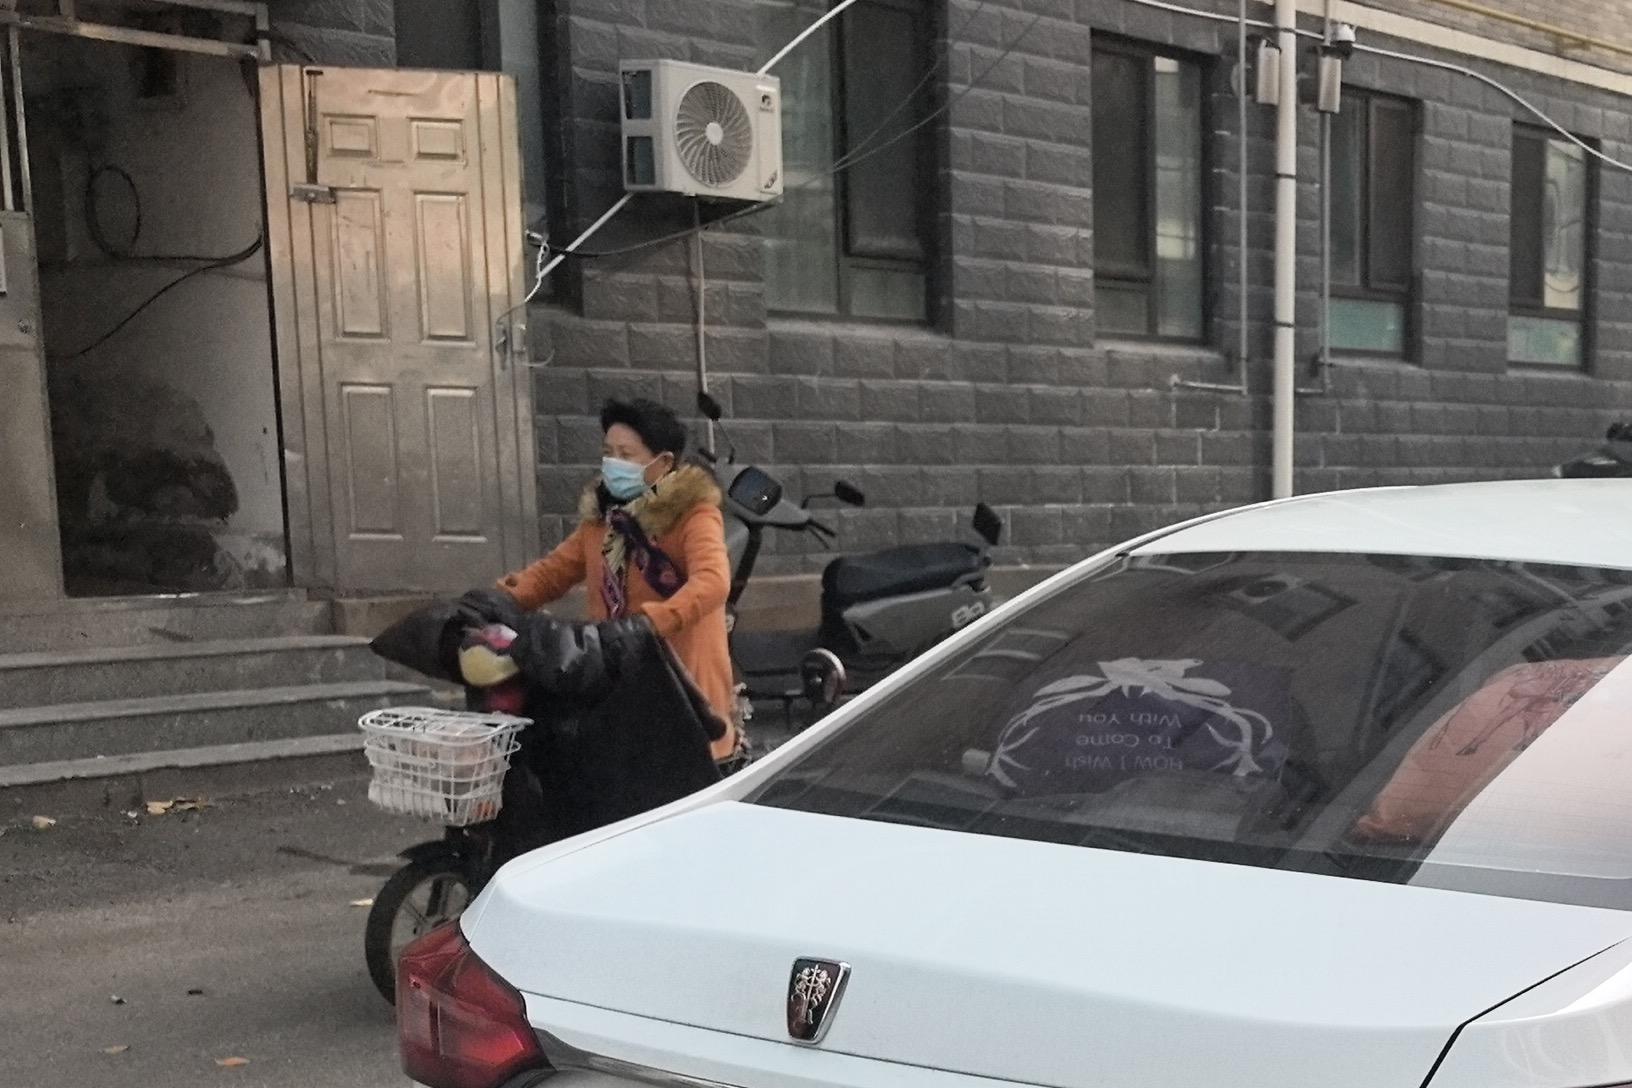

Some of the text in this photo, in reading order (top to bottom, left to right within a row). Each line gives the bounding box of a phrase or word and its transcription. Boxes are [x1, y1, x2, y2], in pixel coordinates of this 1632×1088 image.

[1079, 712, 1183, 729] With You
[1075, 733, 1176, 751] To Come
